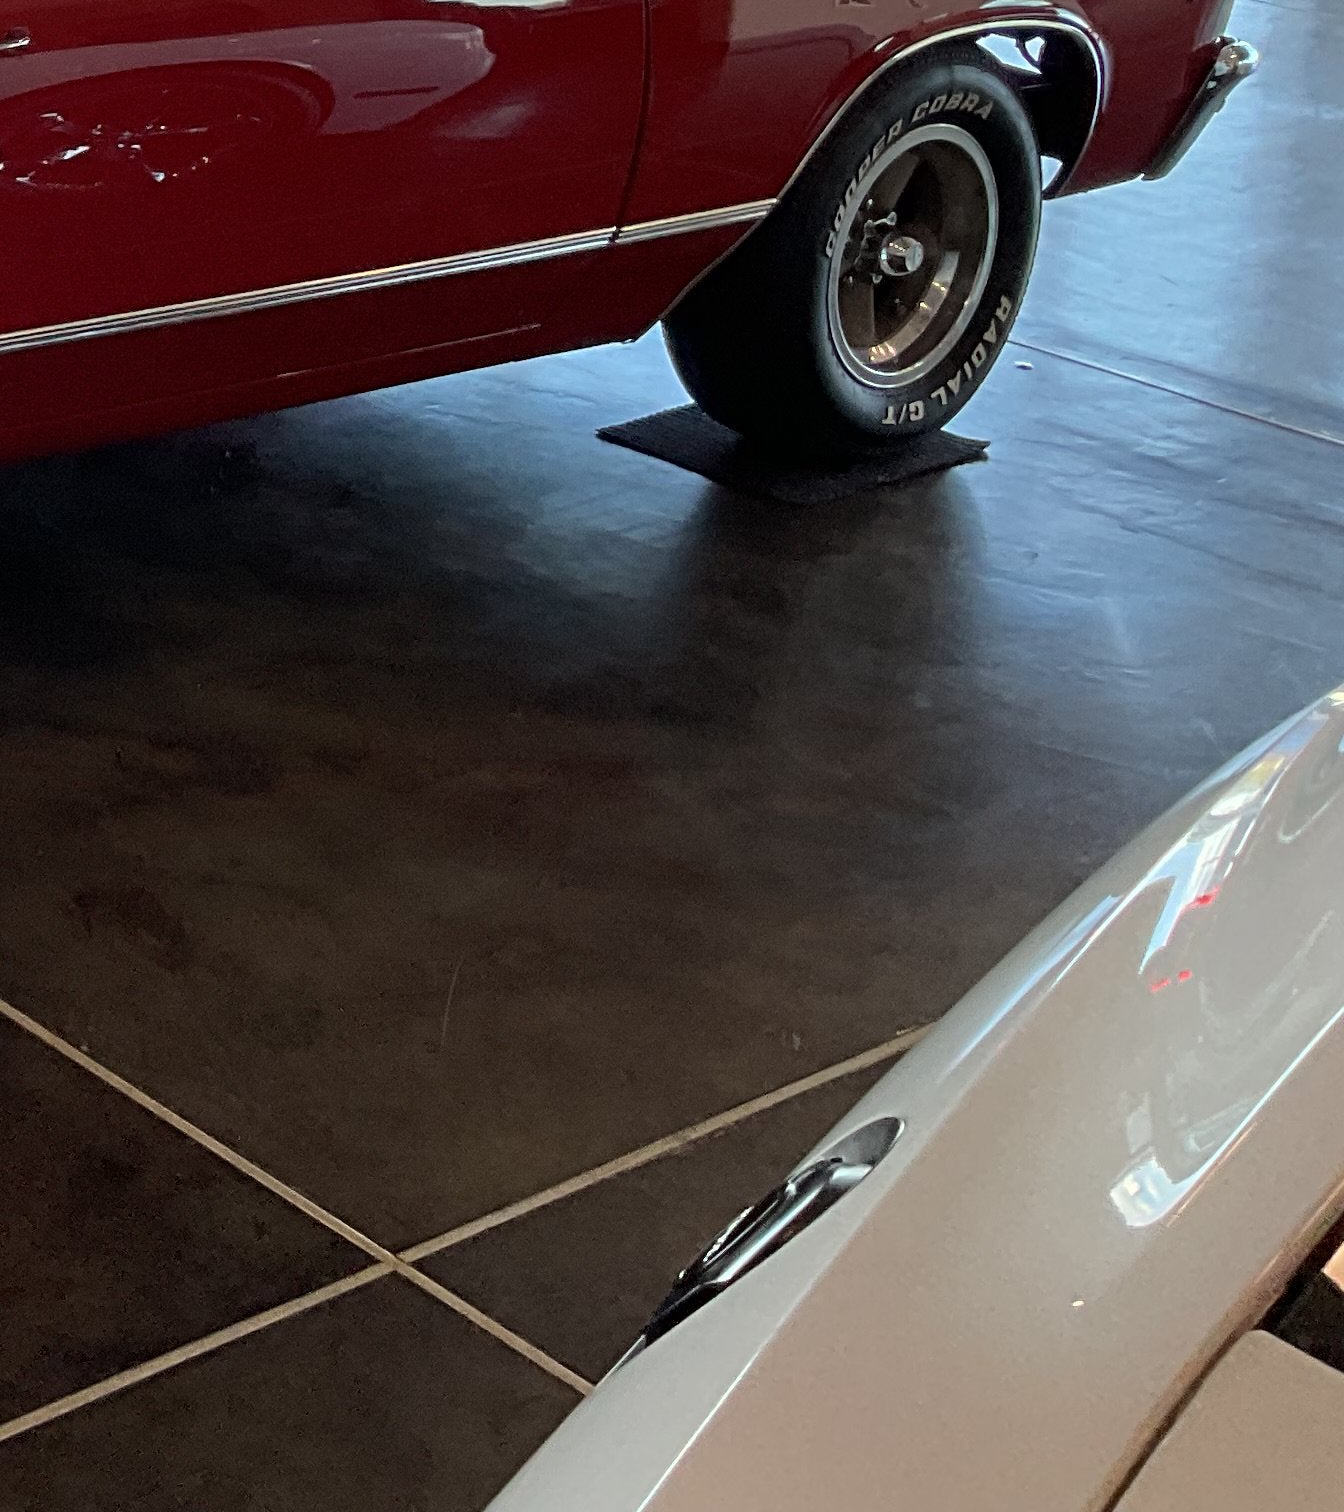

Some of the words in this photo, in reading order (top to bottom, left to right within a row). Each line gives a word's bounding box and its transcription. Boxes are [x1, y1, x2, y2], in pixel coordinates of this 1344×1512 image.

[825, 118, 904, 258] COOPER
[911, 91, 994, 123] COBRA
[930, 294, 1013, 406] RADIAL
